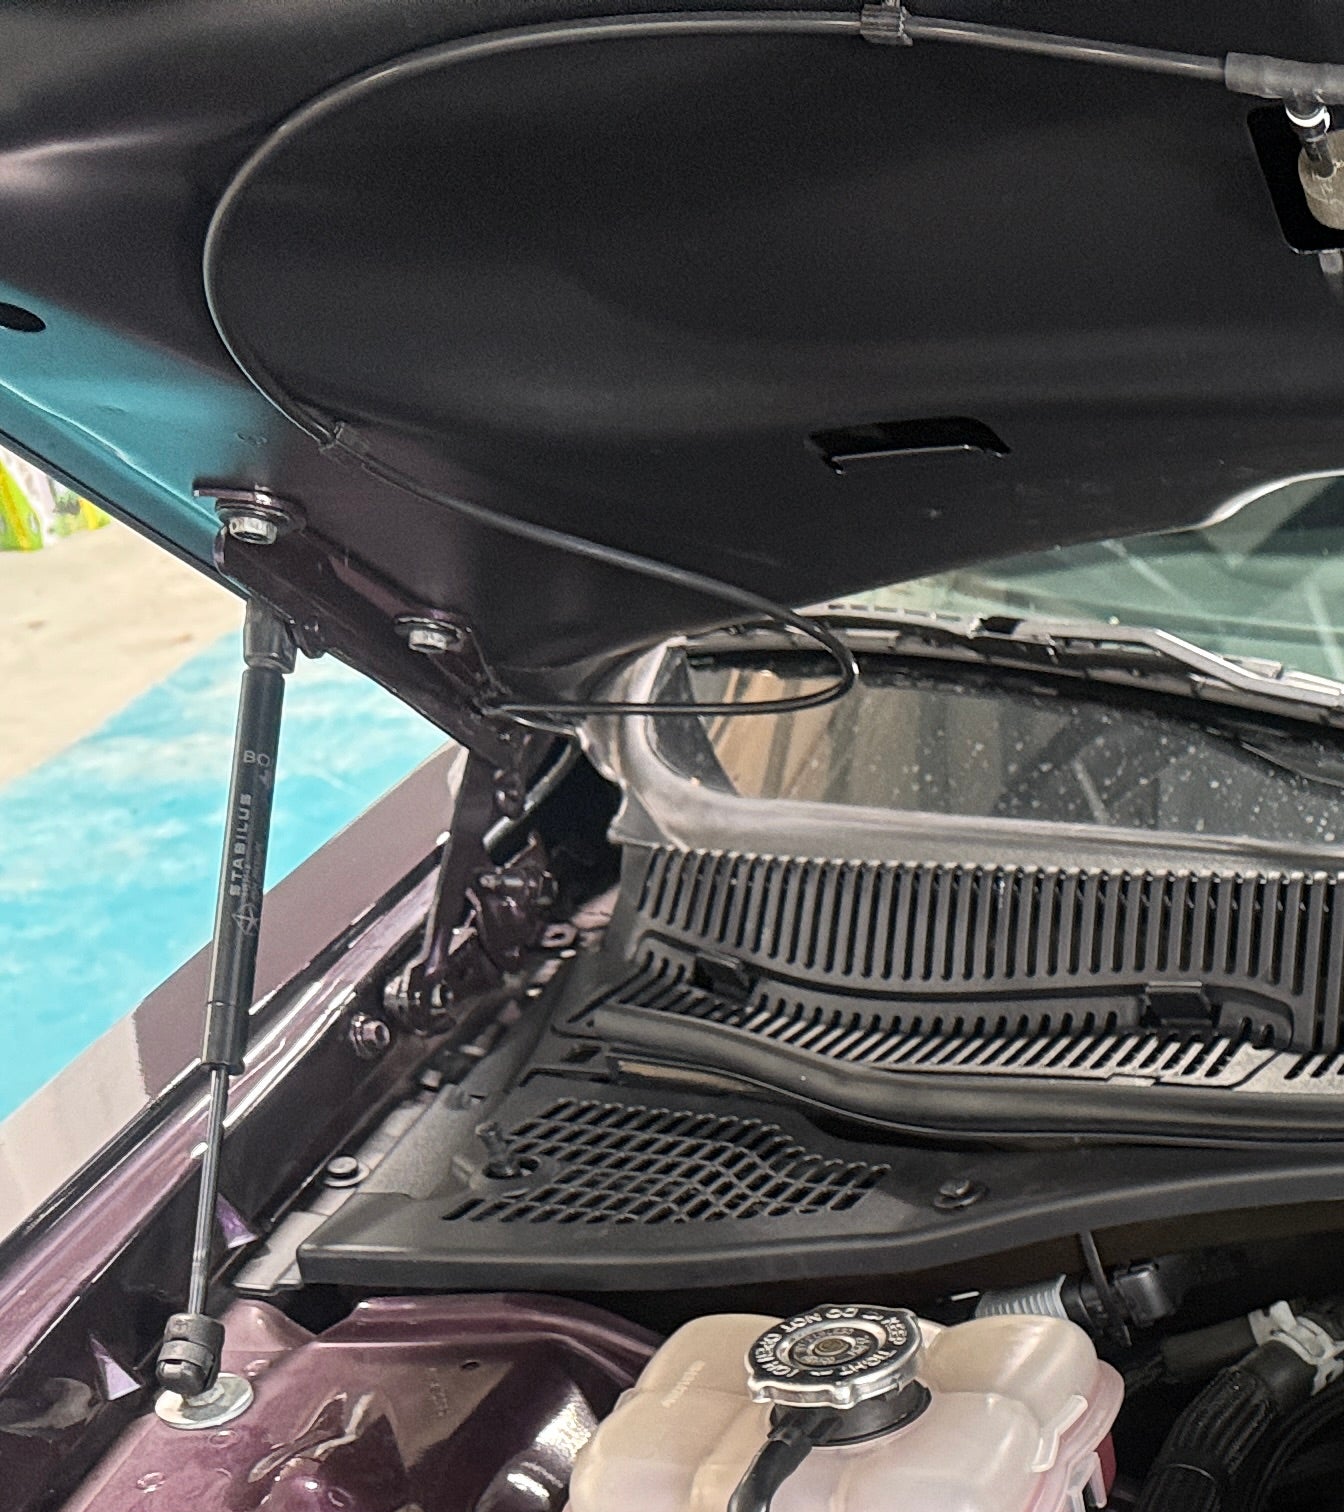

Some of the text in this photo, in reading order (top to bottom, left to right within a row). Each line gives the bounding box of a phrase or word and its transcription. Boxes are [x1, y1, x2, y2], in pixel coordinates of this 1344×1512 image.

[229, 793, 252, 896] STABILUS
[780, 1312, 823, 1333] NOT
[825, 1307, 859, 1319] DO
[839, 1317, 908, 1377] KEEP TIGHT
